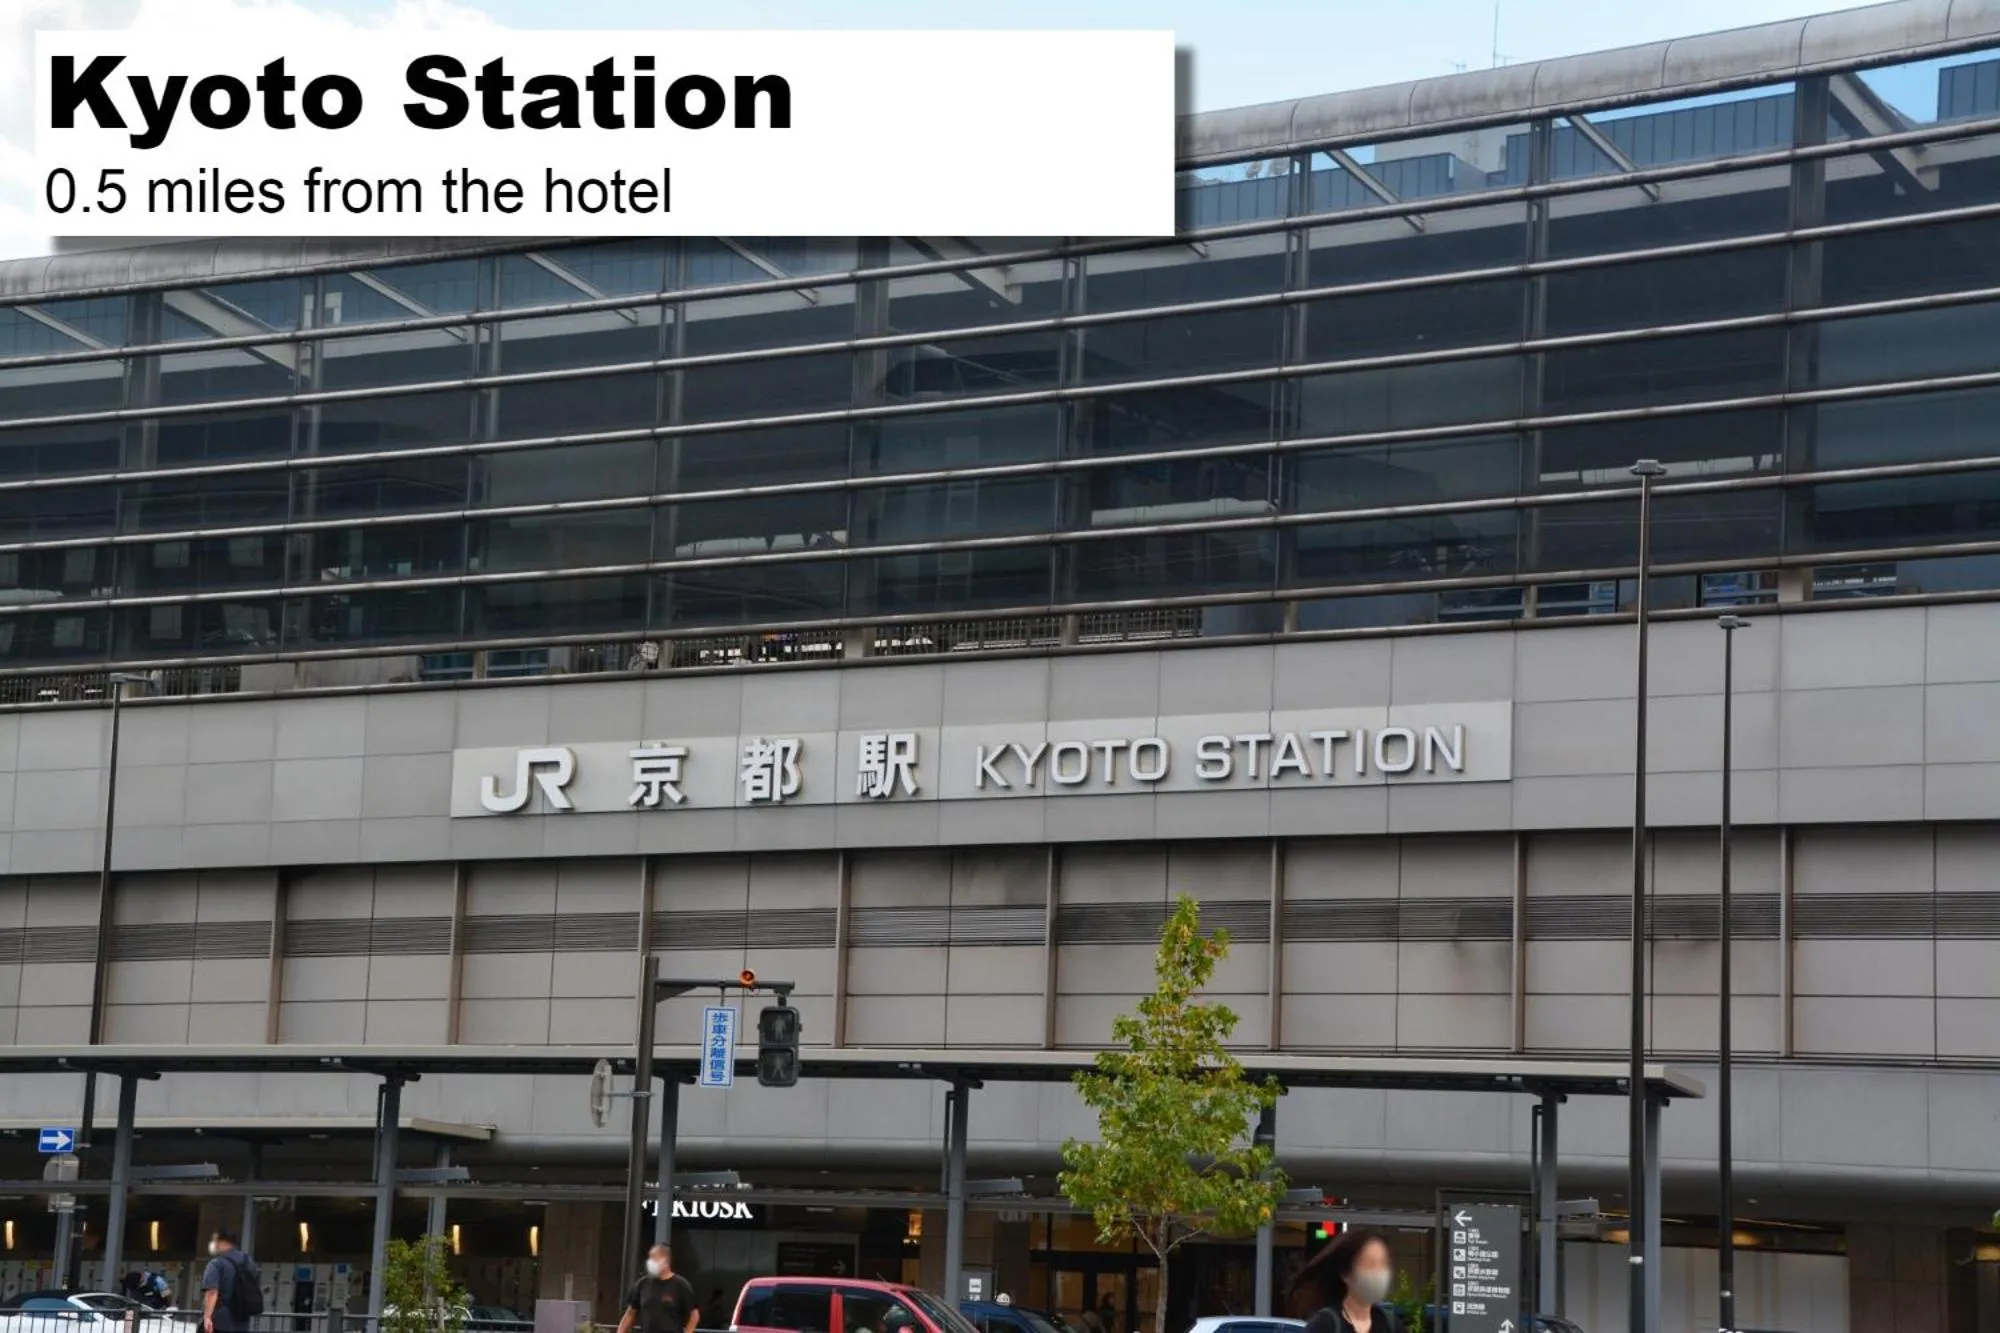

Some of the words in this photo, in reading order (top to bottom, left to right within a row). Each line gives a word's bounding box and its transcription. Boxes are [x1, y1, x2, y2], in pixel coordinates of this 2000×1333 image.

[480, 746, 577, 813] JR
[628, 732, 920, 809] 京都駅
[974, 736, 1171, 790] KYOTO
[1194, 723, 1467, 780] STATION
[671, 1200, 754, 1219] KIOSK
